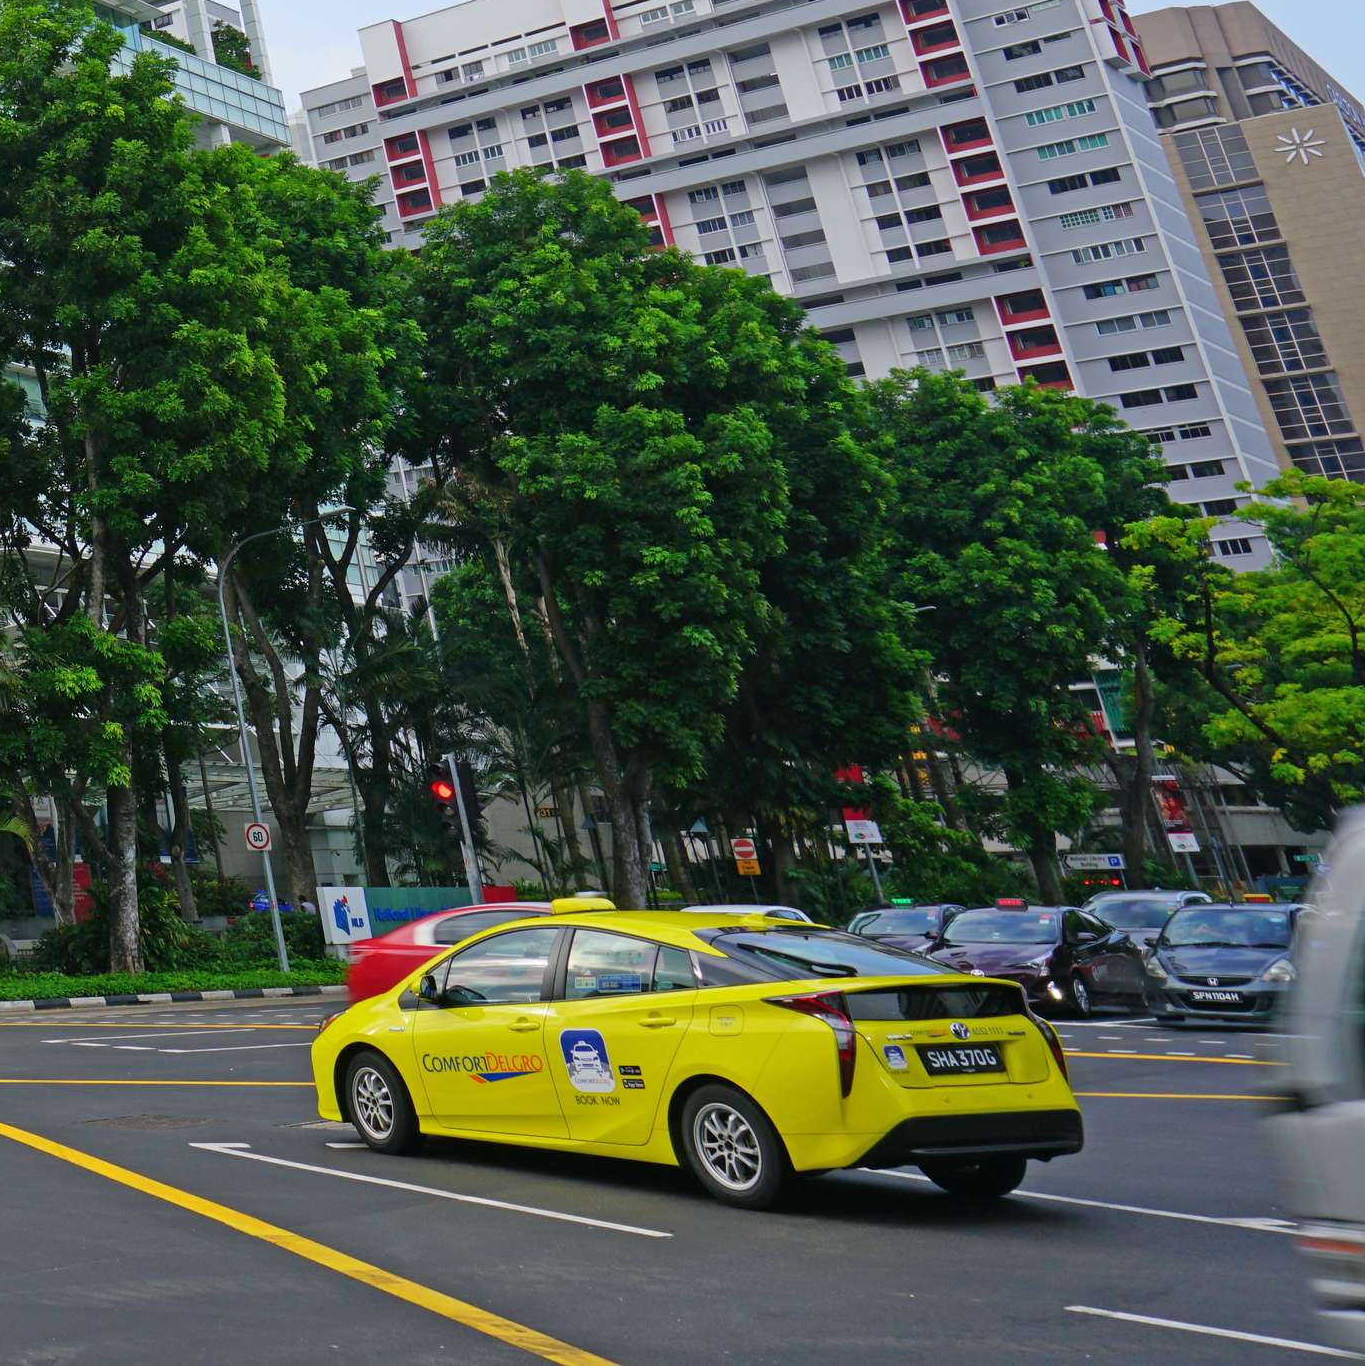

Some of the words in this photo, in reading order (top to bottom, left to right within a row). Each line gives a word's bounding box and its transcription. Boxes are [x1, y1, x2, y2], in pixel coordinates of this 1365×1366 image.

[253, 831, 263, 842] 60
[927, 1049, 997, 1068] SHA370G
[575, 1095, 599, 1105] BOOK
[601, 1096, 621, 1106] NOW
